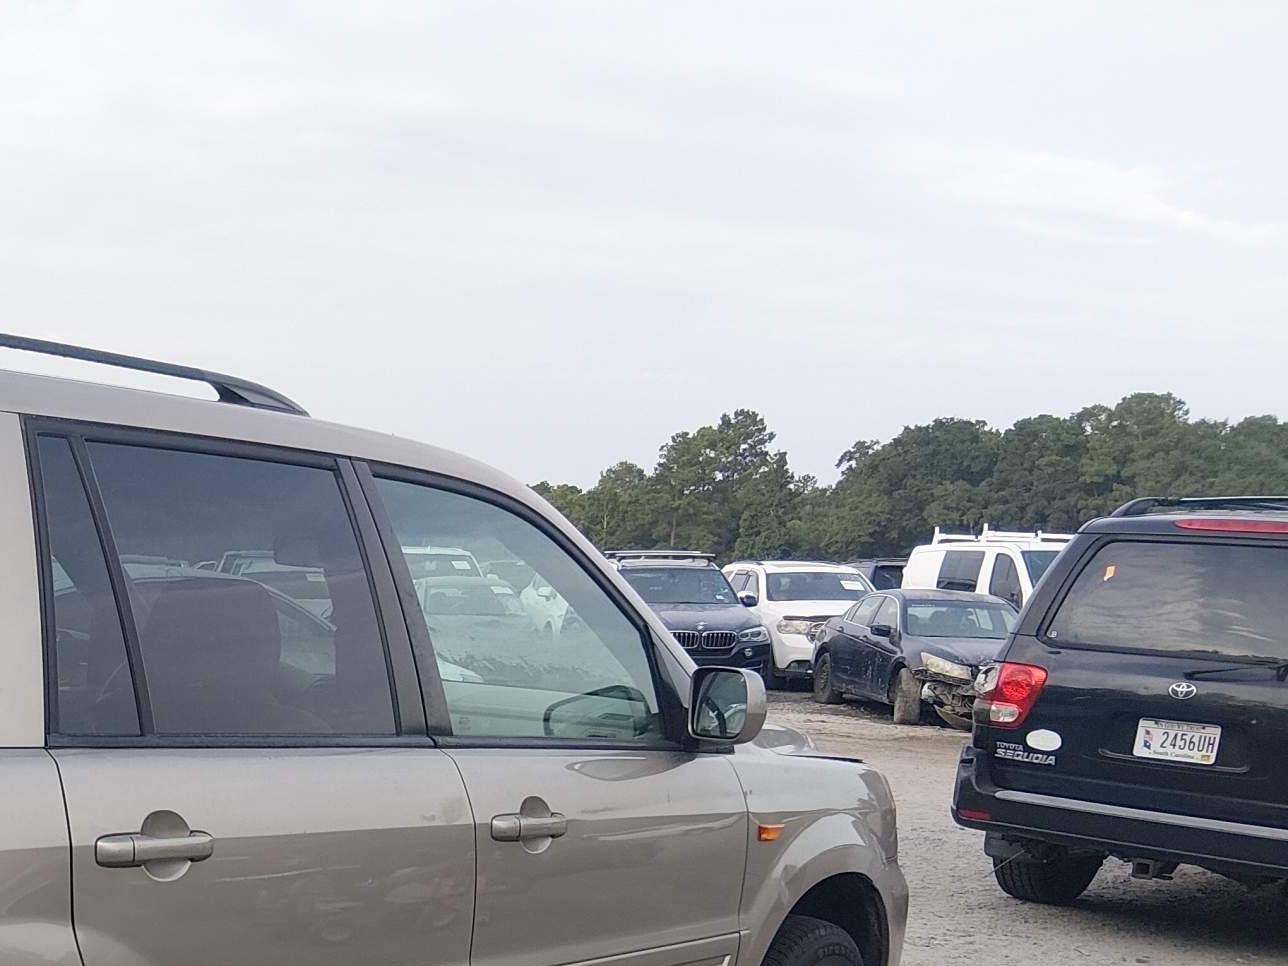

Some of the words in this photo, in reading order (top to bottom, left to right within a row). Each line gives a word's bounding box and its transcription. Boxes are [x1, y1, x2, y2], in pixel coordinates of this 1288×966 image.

[996, 741, 1024, 752] TOYOTA
[1160, 731, 1216, 754] 2456UH
[994, 748, 1056, 766] SEQUOIA
